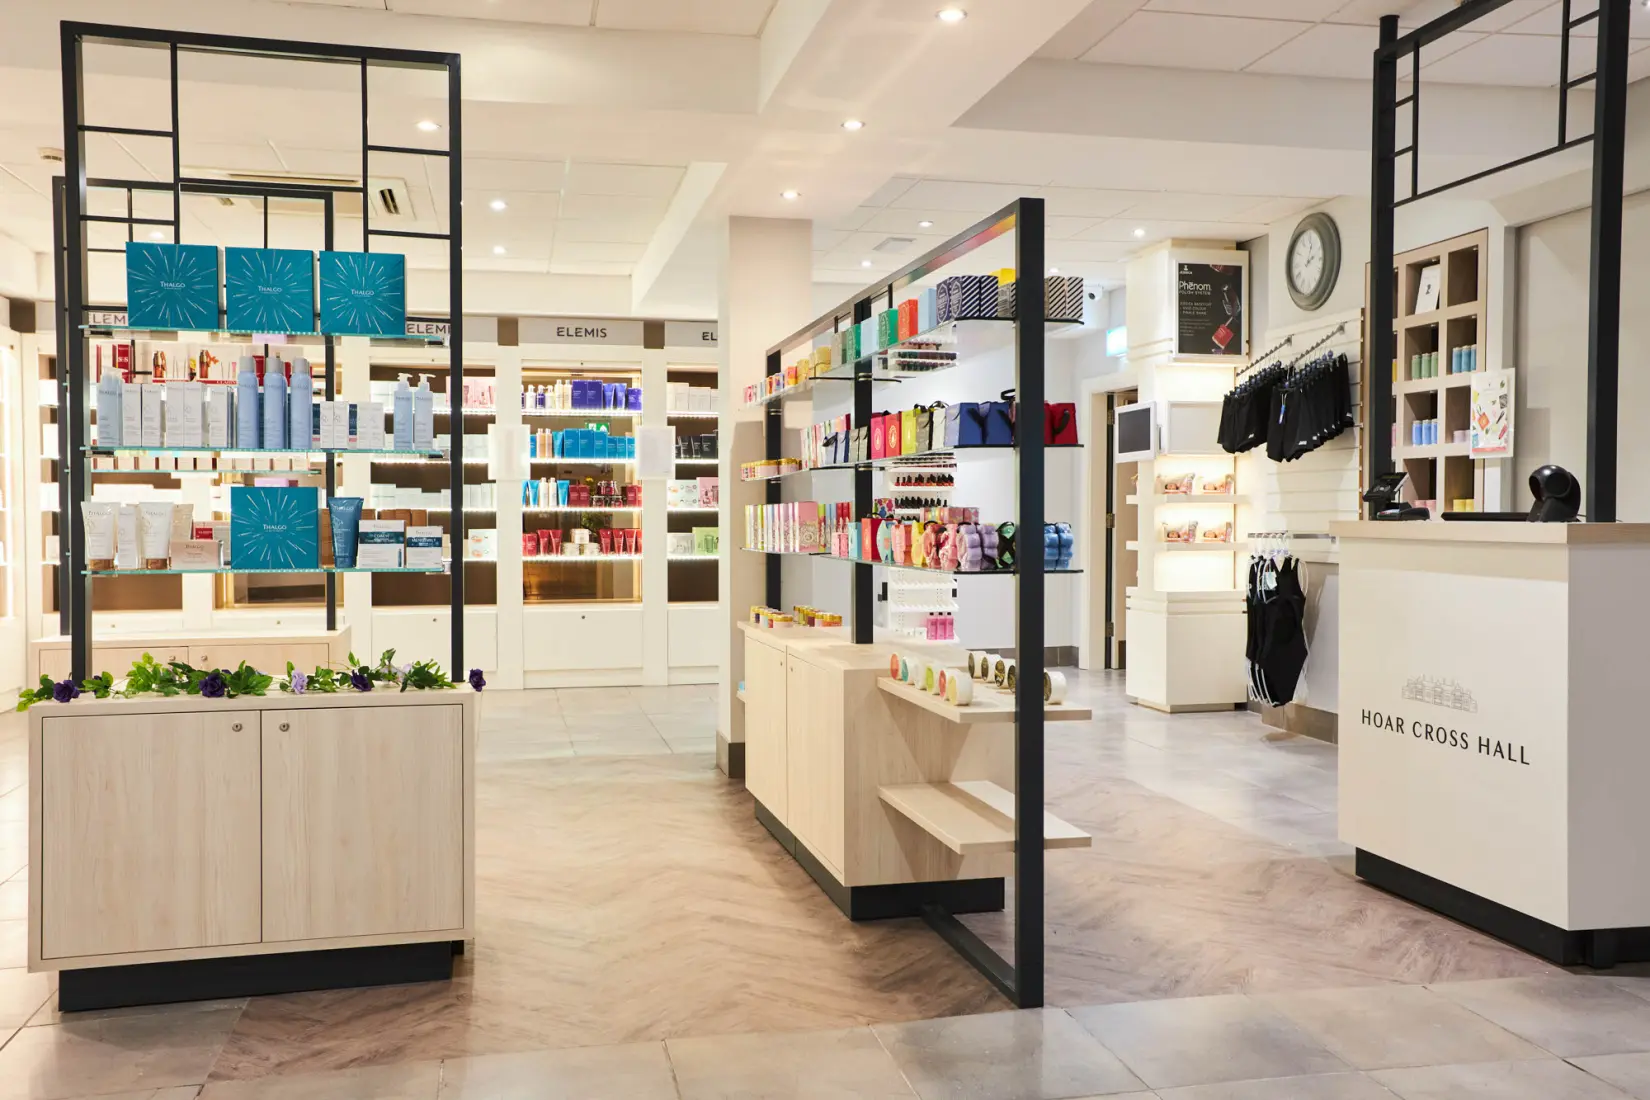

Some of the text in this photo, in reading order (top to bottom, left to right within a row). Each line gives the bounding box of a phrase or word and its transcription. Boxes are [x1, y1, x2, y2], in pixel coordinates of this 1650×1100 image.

[160, 280, 186, 288] THALGO
[257, 285, 283, 293] THALGO
[351, 288, 375, 296] THALGO
[92, 313, 126, 325] LEM
[406, 323, 451, 335] ELEMI
[556, 326, 607, 338] ELEMIS
[1361, 708, 1530, 766] HOAR CROSS HALL
